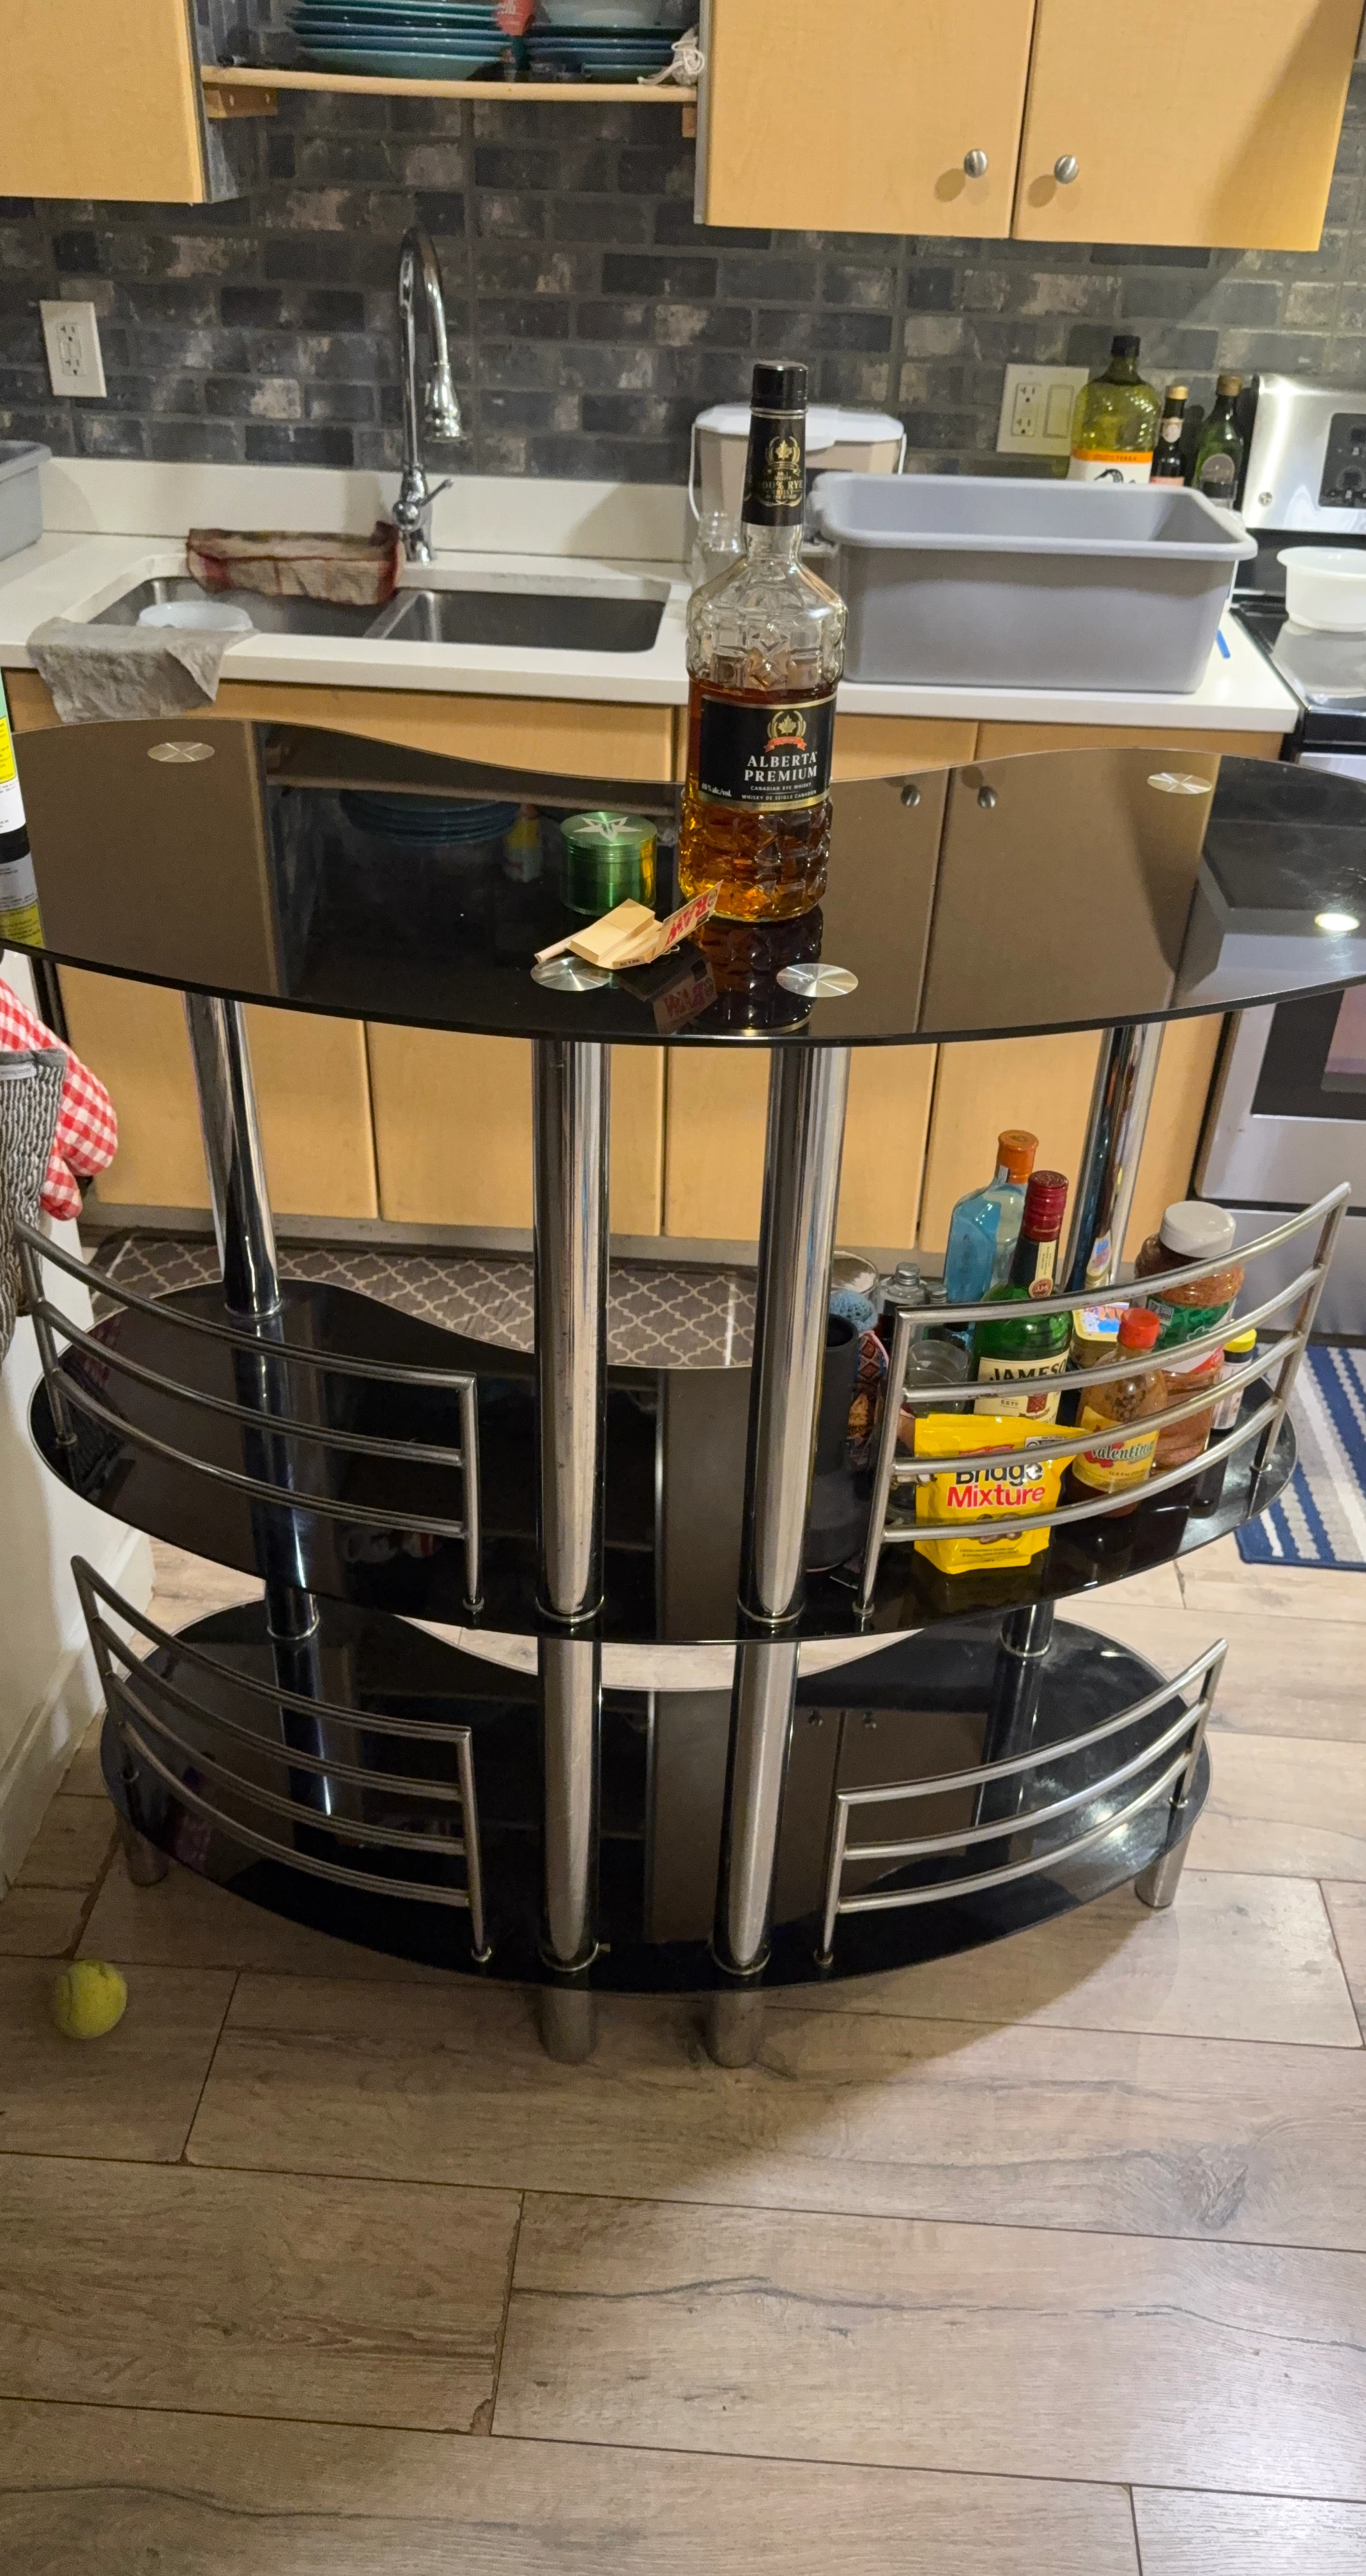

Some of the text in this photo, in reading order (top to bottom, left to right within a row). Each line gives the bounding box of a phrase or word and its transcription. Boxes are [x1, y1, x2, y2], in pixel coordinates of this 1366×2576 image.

[788, 480, 803, 489] RYE
[747, 751, 817, 767] ALBERTA
[744, 765, 817, 782] PREMIUM
[946, 1483, 1046, 1508] Mixture
